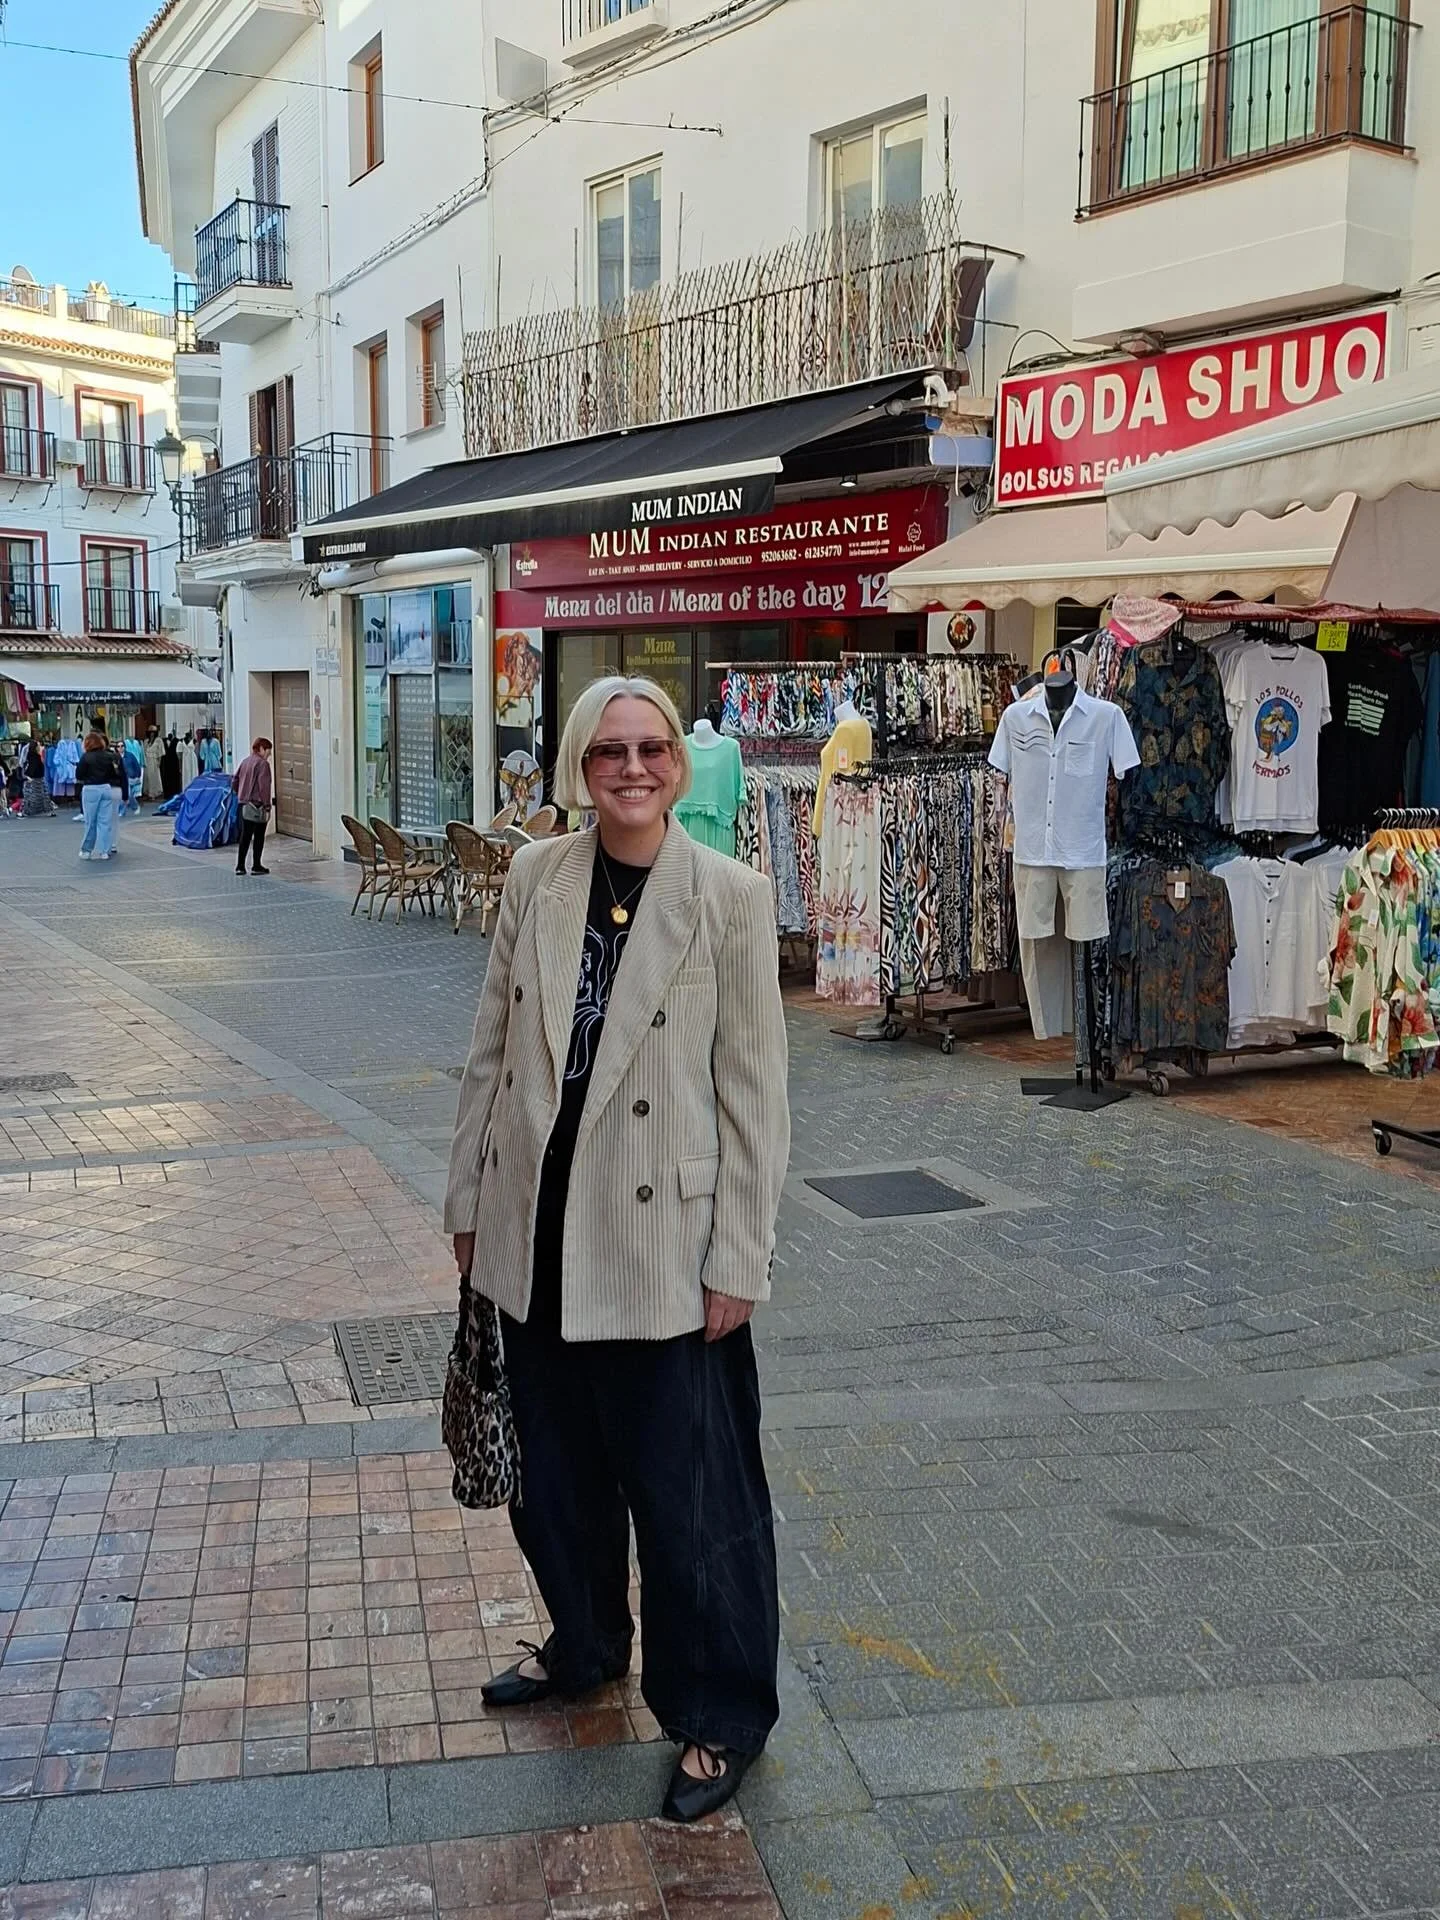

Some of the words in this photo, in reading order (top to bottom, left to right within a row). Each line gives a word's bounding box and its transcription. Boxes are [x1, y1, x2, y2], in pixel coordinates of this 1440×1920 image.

[1005, 366, 1167, 448] MODA
[1186, 326, 1381, 420] SHUO
[631, 499, 672, 522] MUM
[677, 487, 743, 519] INDIAN
[588, 526, 652, 559] MUM
[659, 530, 727, 553] INDIAN
[735, 512, 890, 545] RESTAURANTE
[761, 550, 797, 563] 952063682
[898, 545, 912, 553] Halal
[913, 544, 925, 552] Food
[609, 566, 621, 575] TAKE
[640, 563, 655, 573] HOME
[656, 561, 682, 572] DELIVERY
[687, 559, 713, 569] SERVICIO
[719, 555, 752, 567] DOMICILIO
[544, 595, 591, 618] Menu
[594, 592, 622, 616] del
[626, 589, 654, 614] dia
[668, 588, 724, 613] Menu
[729, 585, 752, 611] of
[757, 584, 796, 610] the
[803, 580, 847, 612] day
[644, 637, 676, 654] Mum
[1255, 687, 1271, 705] LOS
[1276, 685, 1304, 709] POLLOS
